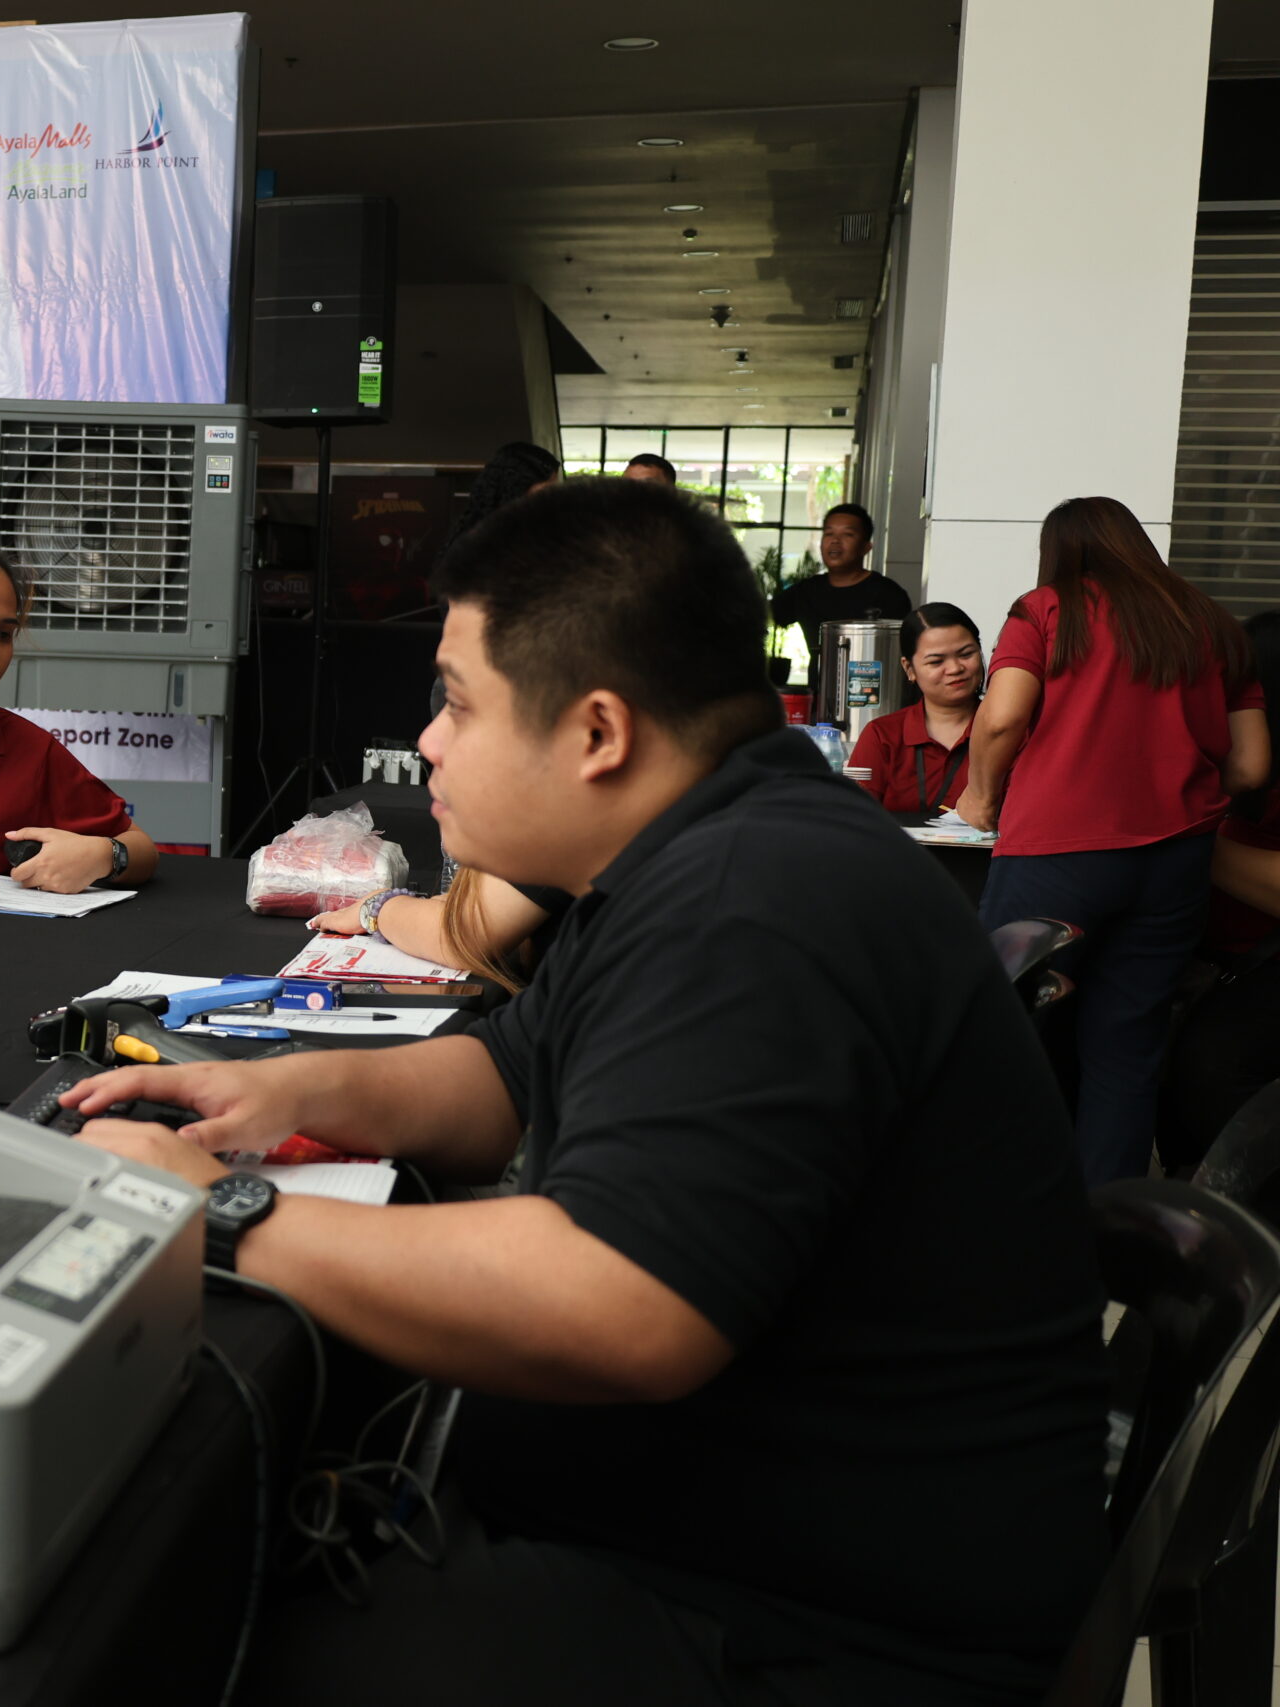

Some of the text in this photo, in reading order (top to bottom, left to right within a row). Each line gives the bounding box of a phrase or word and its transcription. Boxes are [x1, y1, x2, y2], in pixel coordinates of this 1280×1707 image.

[94, 156, 200, 170] HARBOR POINT
[207, 430, 234, 439] iwata
[117, 728, 174, 749] Zone
